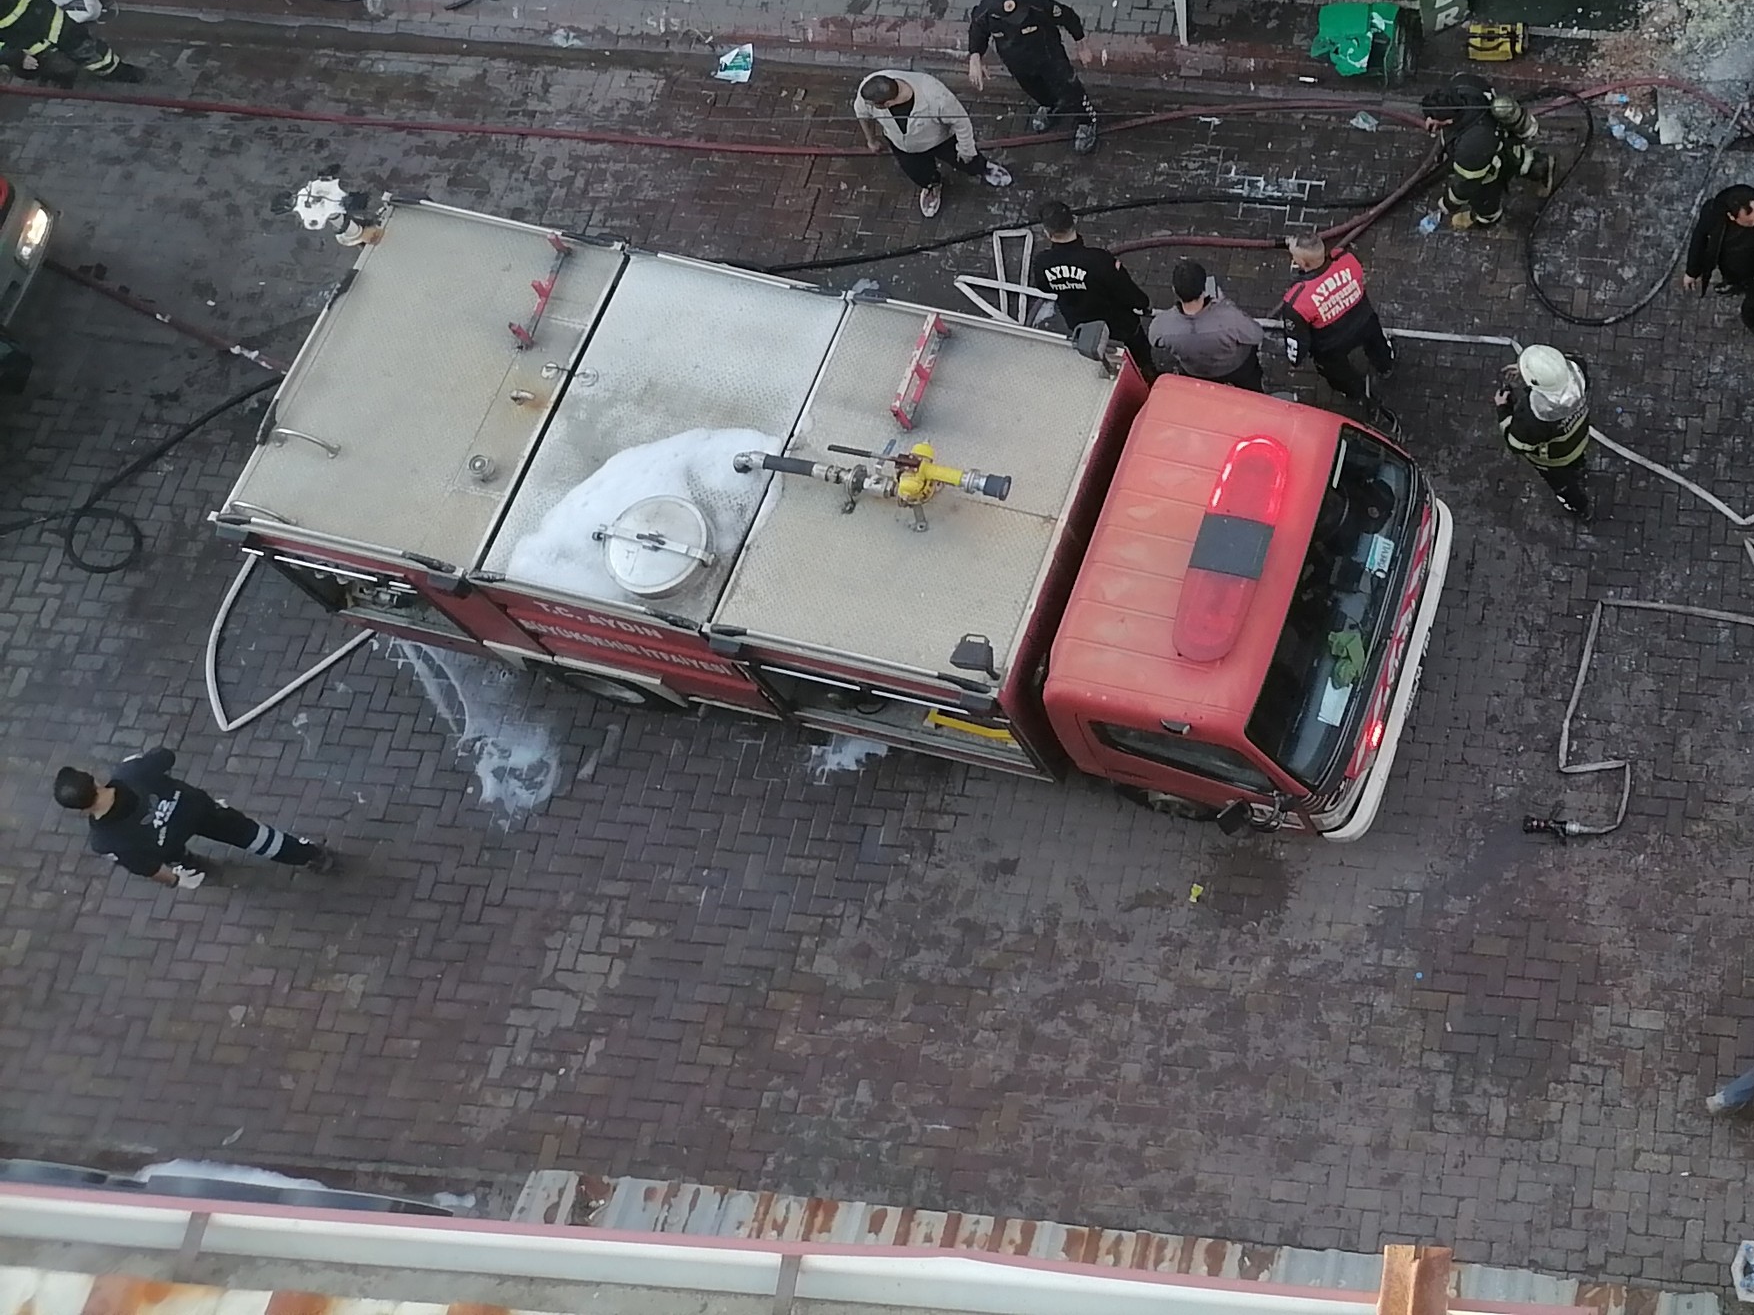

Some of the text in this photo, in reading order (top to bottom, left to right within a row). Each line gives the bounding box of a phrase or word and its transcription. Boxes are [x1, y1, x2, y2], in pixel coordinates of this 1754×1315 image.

[1044, 264, 1088, 282] AYDIN
[1310, 268, 1352, 305] AYDIN
[532, 600, 664, 640] T.C. AYDIN
[152, 799, 171, 829] 112
